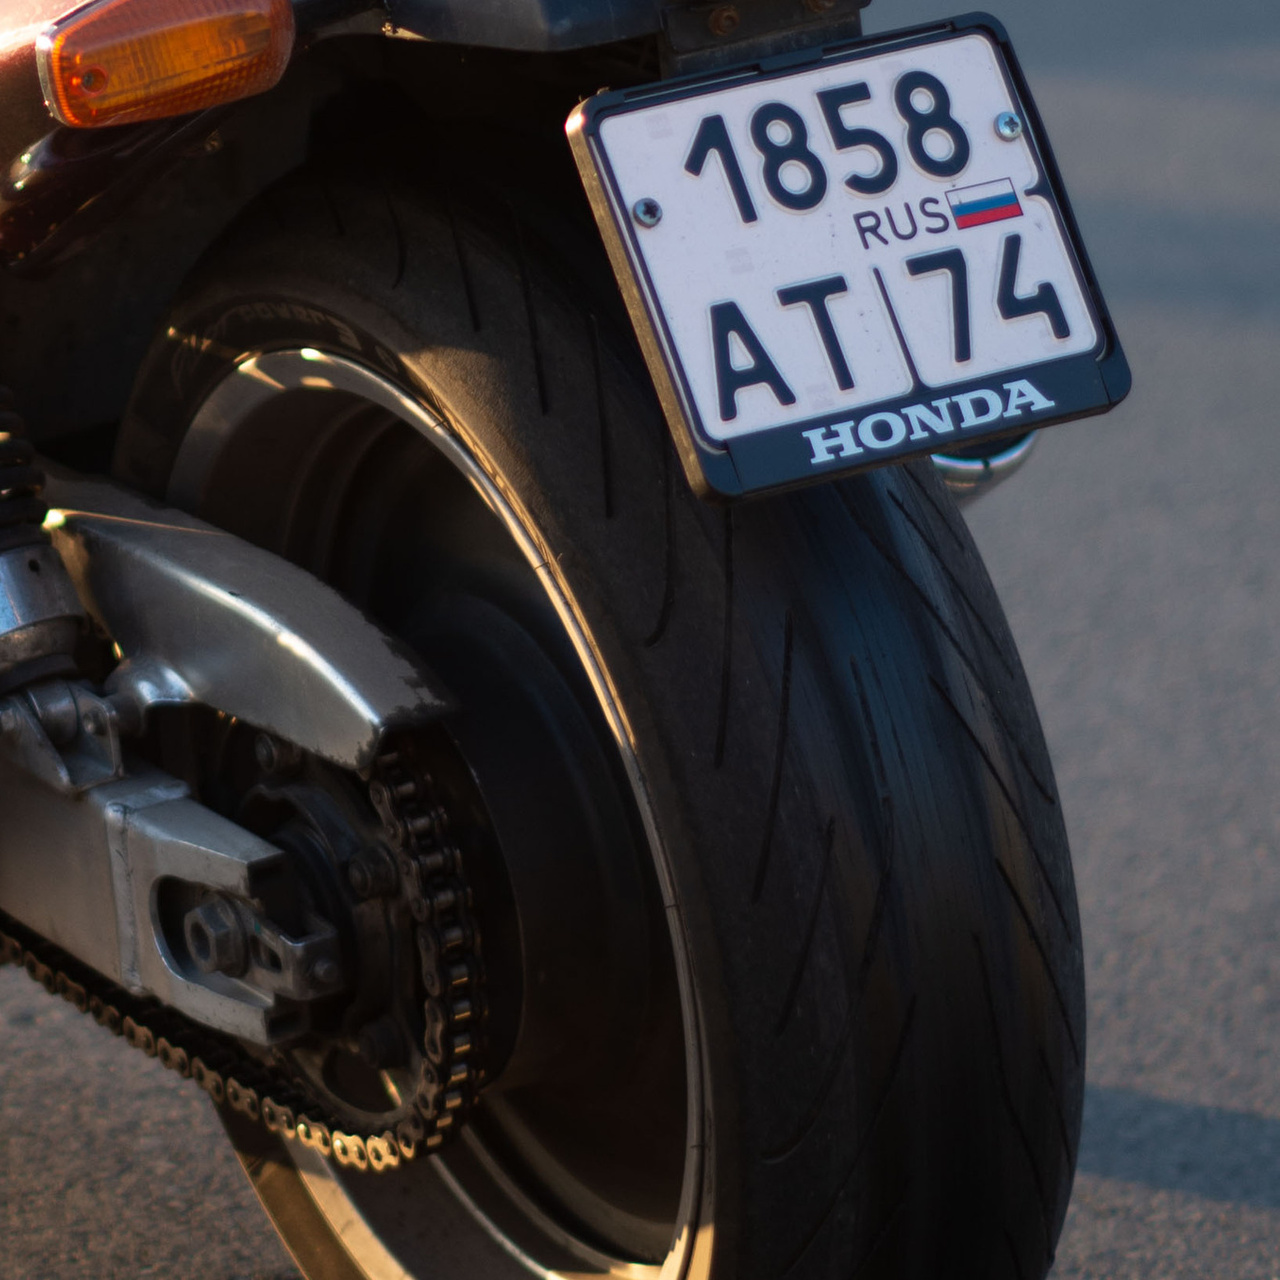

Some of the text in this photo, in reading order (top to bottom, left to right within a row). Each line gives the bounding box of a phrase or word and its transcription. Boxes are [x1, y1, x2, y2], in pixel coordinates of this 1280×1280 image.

[685, 70, 970, 223] 1858
[853, 197, 950, 250] RUS
[709, 233, 1071, 422] AT 74
[802, 379, 1055, 464] HONDA
